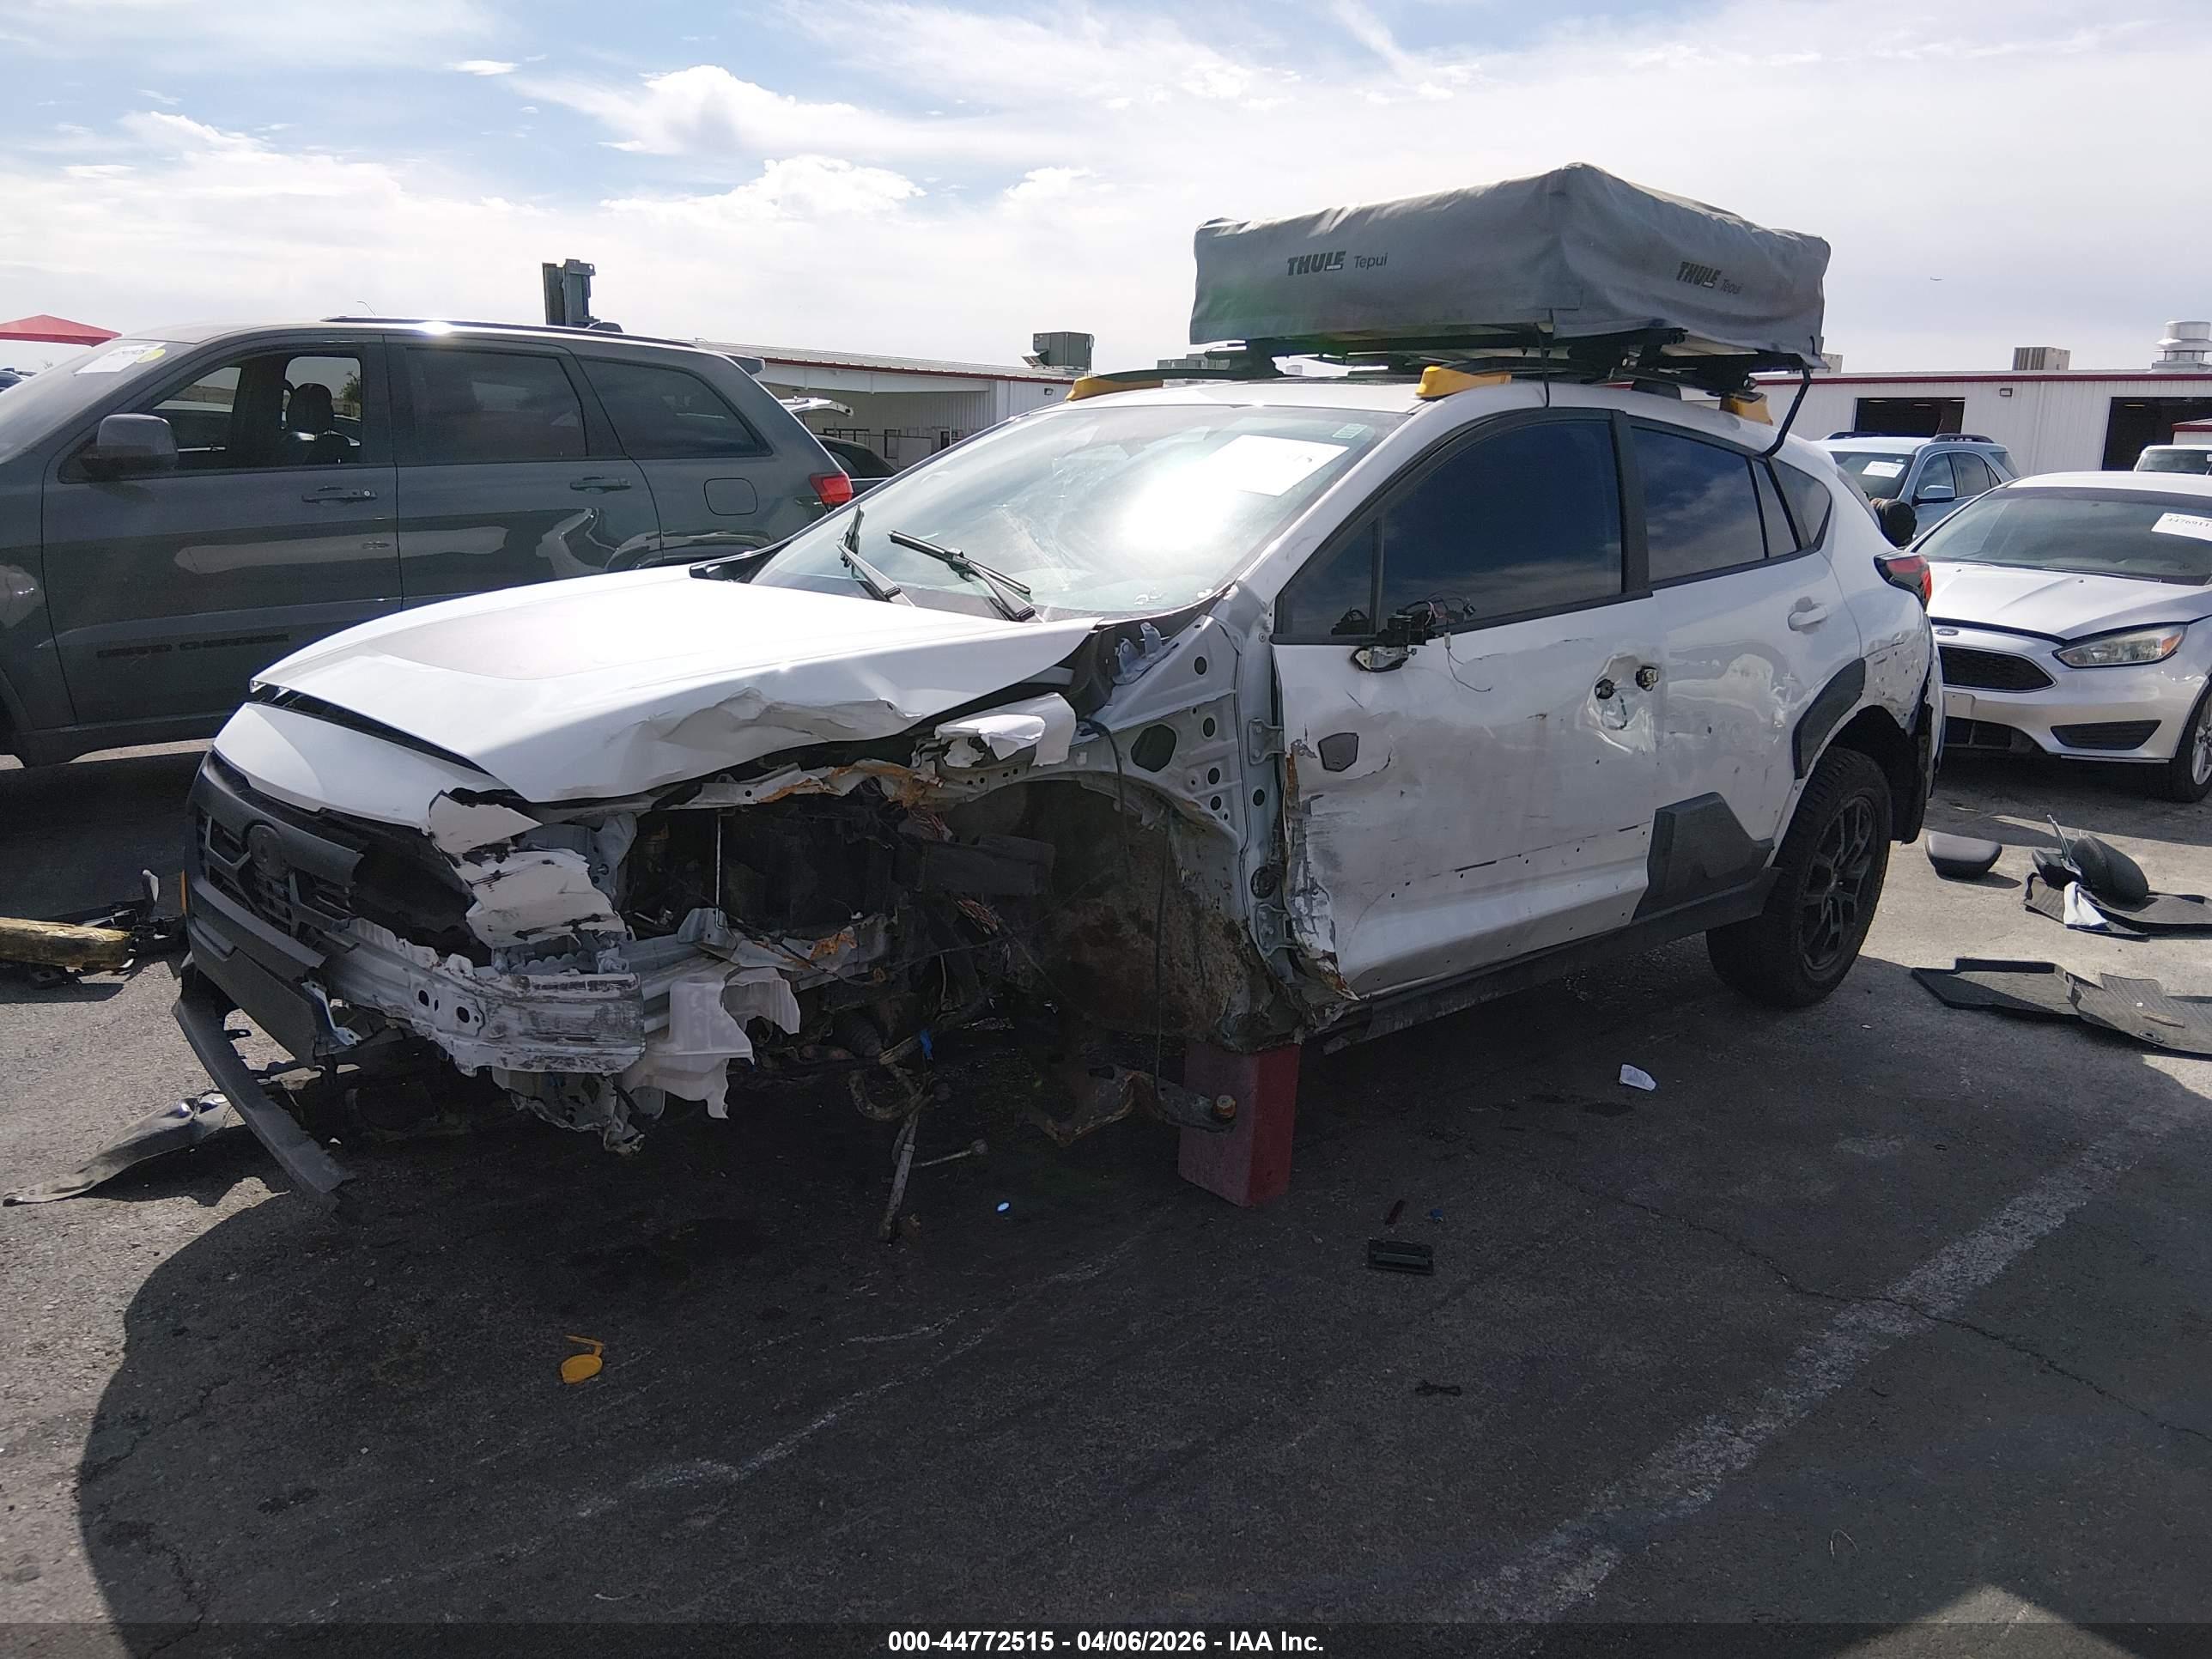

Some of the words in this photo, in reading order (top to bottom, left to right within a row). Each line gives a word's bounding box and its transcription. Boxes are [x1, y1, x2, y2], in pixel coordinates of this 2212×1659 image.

[1287, 251, 1346, 276] THULE
[1354, 252, 1389, 270] Tepui
[1676, 261, 1723, 289] THULE
